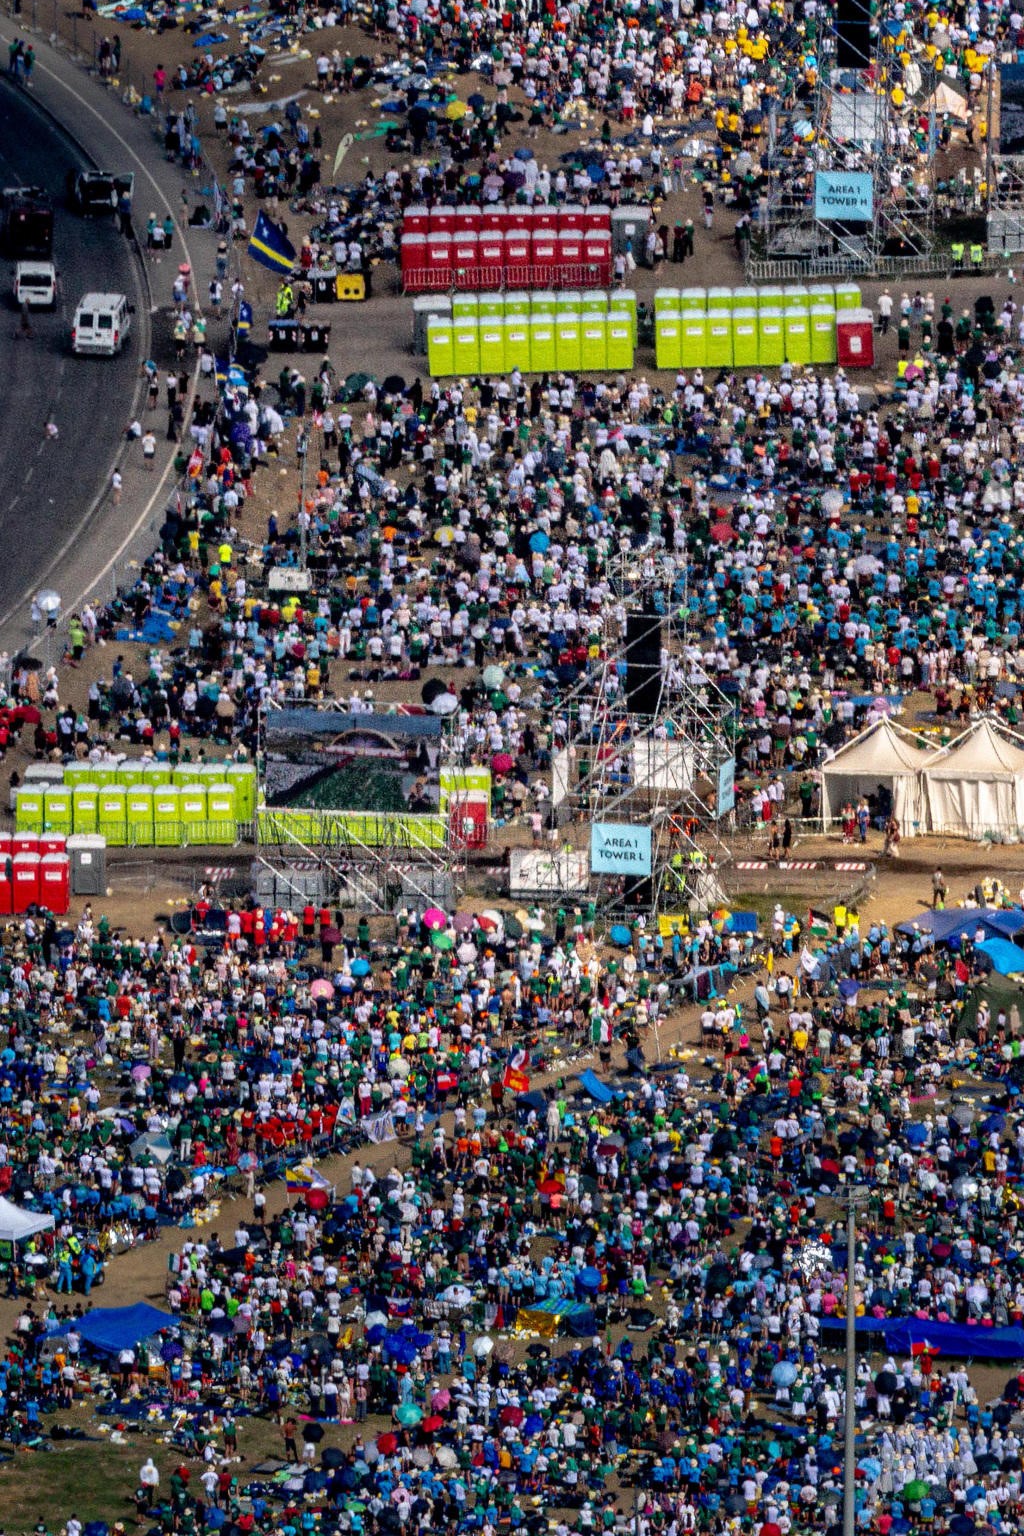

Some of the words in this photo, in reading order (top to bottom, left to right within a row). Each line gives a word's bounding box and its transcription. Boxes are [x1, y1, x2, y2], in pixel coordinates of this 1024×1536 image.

[828, 185, 854, 194] AREA
[822, 196, 857, 206] TOWER
[861, 198, 867, 206] H
[604, 837, 632, 848] AREA
[598, 848, 636, 861] TOWER
[638, 852, 644, 861] L
